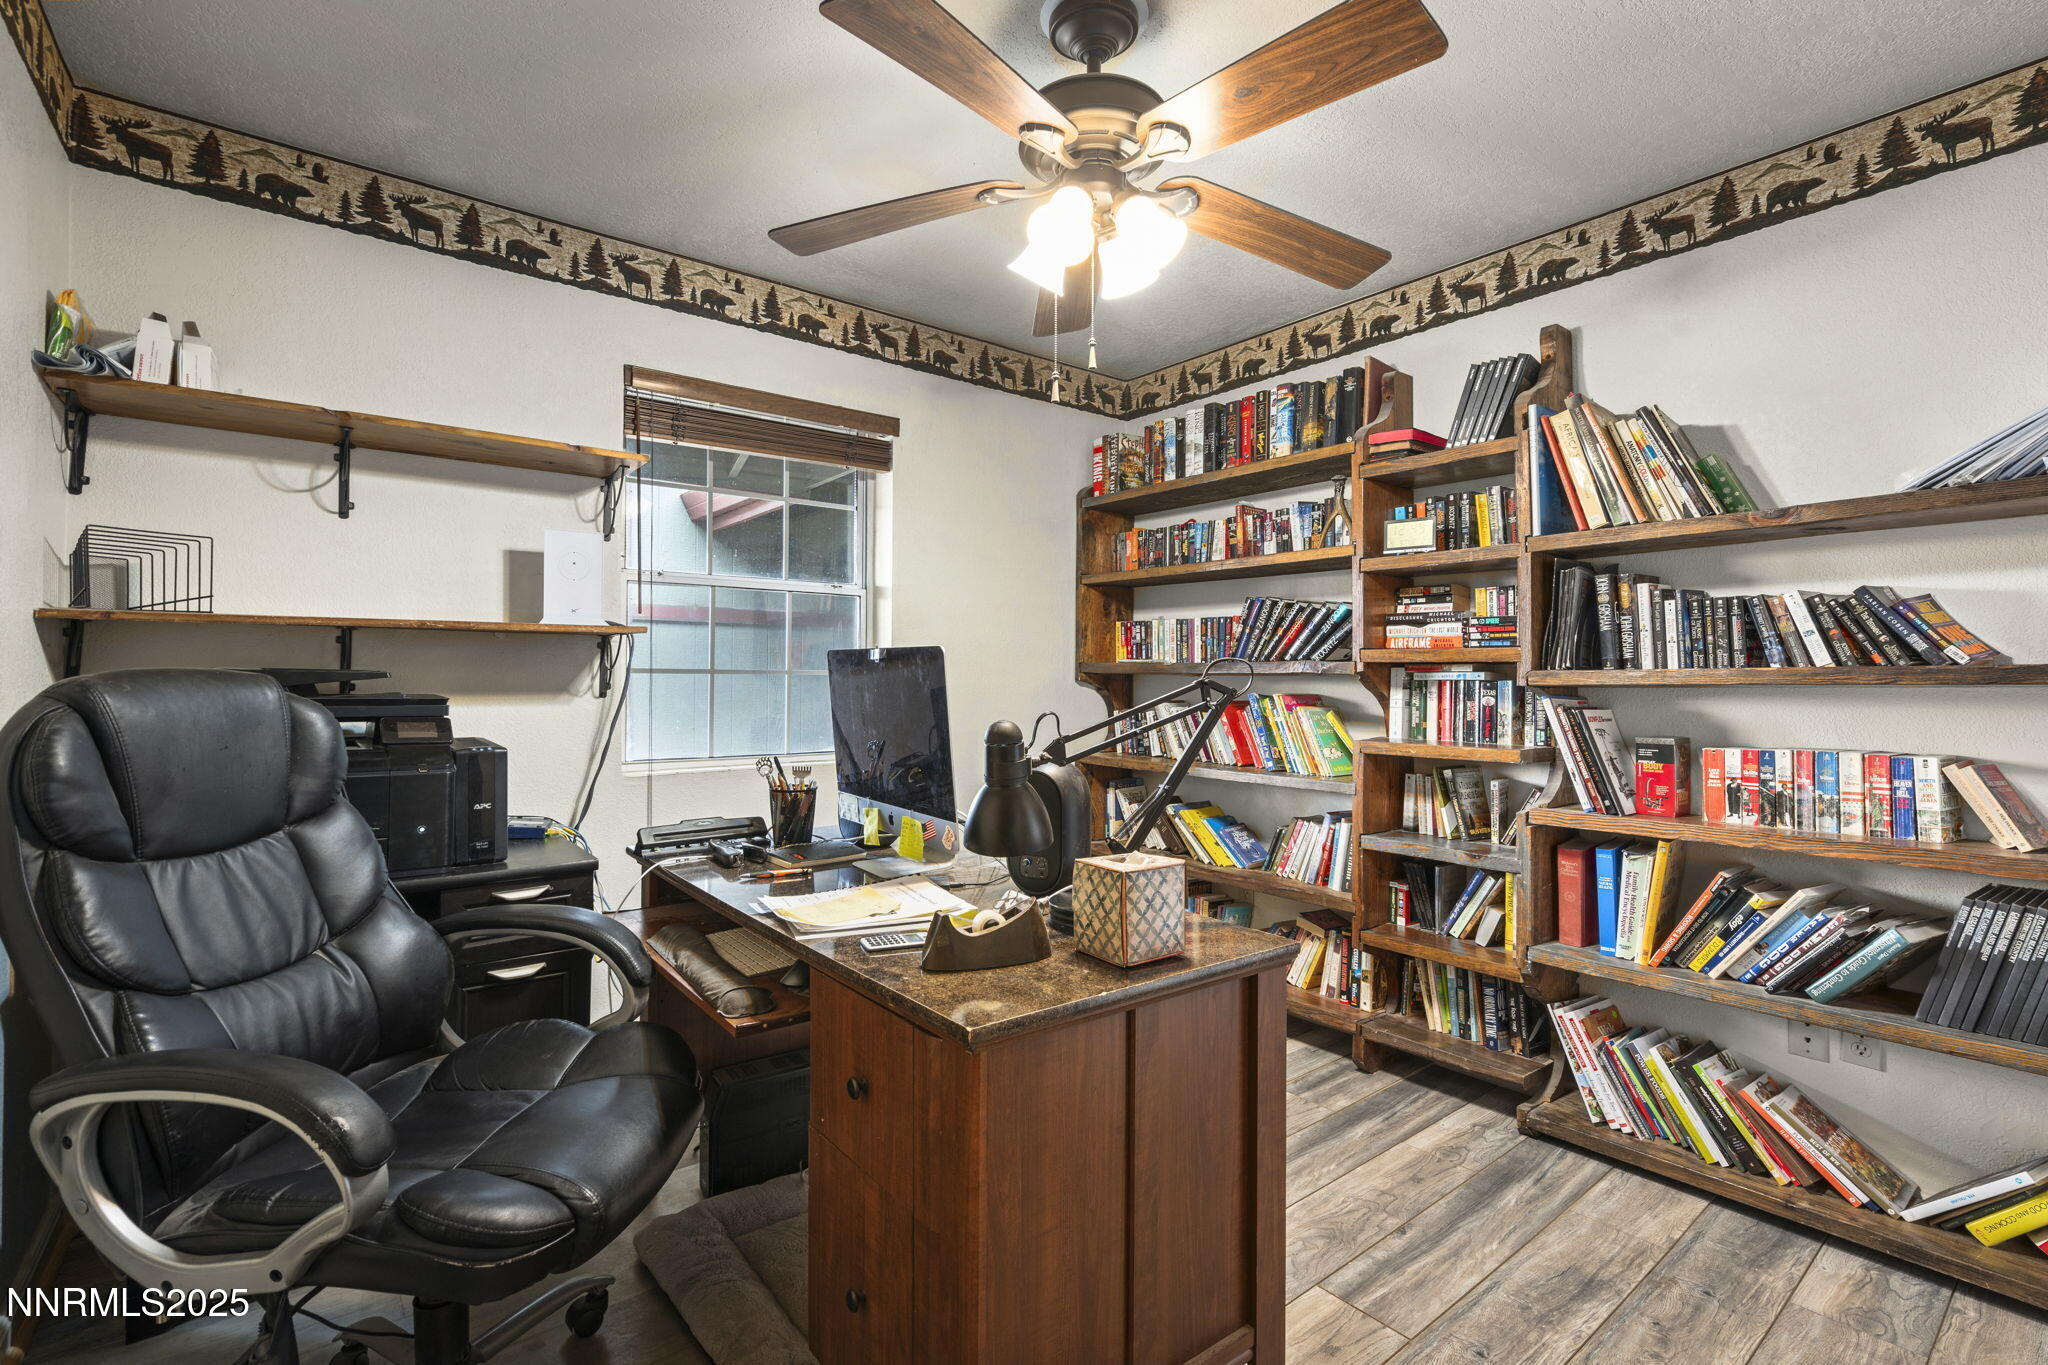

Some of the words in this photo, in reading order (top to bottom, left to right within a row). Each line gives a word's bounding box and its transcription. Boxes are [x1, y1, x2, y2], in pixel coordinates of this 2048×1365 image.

[1227, 414, 1236, 436] KING
[1580, 424, 1595, 451] AMERICAN
[1625, 438, 1643, 466] ANATOMY
[1092, 455, 1102, 482] KING
[1596, 577, 1608, 593] JOHN
[1597, 603, 1611, 631] GRISHAM
[1620, 615, 1632, 631] JOHN
[1860, 611, 1869, 621] THE
[1863, 592, 1887, 616] HARLAN
[1886, 614, 1908, 636] COBEN
[1314, 635, 1338, 661] KOONTZ
[1390, 637, 1432, 648] AIRFRAME
[1621, 631, 1634, 658] GRISHAM
[1832, 639, 1847, 662] GRISHAM
[1840, 641, 1851, 656] JOHN
[1525, 704, 1533, 723] BROWN
[1536, 710, 1545, 728] BROWN
[1555, 706, 1569, 731] STRENGTH
[1565, 730, 1577, 752] TRAINING
[1573, 751, 1581, 761] FOR
[1577, 760, 1588, 779] WOMEN
[1583, 750, 1592, 765] BODY
[1590, 766, 1599, 781] PLAN
[1623, 870, 1633, 896] Medical
[1630, 871, 1640, 893] Family
[1628, 894, 1638, 915] Health
[1700, 910, 1709, 919] HOW
[1973, 905, 1982, 917] THE
[1984, 908, 1993, 919] THE
[1618, 897, 1630, 938] Encyclopedia
[1626, 915, 1635, 935] Guide
[1675, 913, 1693, 934] ROOFING
[1726, 912, 1745, 932] eBay
[1789, 912, 1825, 945] WATER
[1965, 915, 1978, 935] OZARKS
[1991, 910, 2006, 935] CANYONS
[2017, 912, 2034, 941] SAGEBRUSH
[2031, 915, 2046, 940] ATLANTIC
[1801, 918, 1839, 951] GAME
[1974, 917, 1990, 943] CASCADES
[1987, 933, 1997, 945] AND
[1660, 935, 1676, 953] SIDING
[1758, 941, 1790, 970] DOG
[1863, 932, 1897, 961] Illustrated
[1980, 944, 1992, 961] MESAS
[2008, 939, 2022, 963] COUNTRY
[2022, 938, 2036, 962] BEACHES
[2036, 940, 2048, 959] SIERRA
[1773, 947, 1802, 972] DOG
[1846, 954, 1868, 973] Guide
[1840, 967, 1850, 977] to
[1483, 986, 1494, 995] NO
[1810, 970, 1844, 999] Gardening
[1483, 995, 1496, 1023] ORDINARY
[1485, 1023, 1496, 1038] TIME
[1633, 1052, 1652, 1077] POWER
[1648, 1076, 1666, 1101] FOODS
[1708, 1106, 1727, 1131] cookbook
[1792, 1130, 1812, 1151] FLAVOR
[1808, 1136, 1823, 1151] BEST
[1829, 1155, 1840, 1166] WW
[1984, 1215, 2017, 1234] COOKING
[2017, 1210, 2030, 1219] AND
